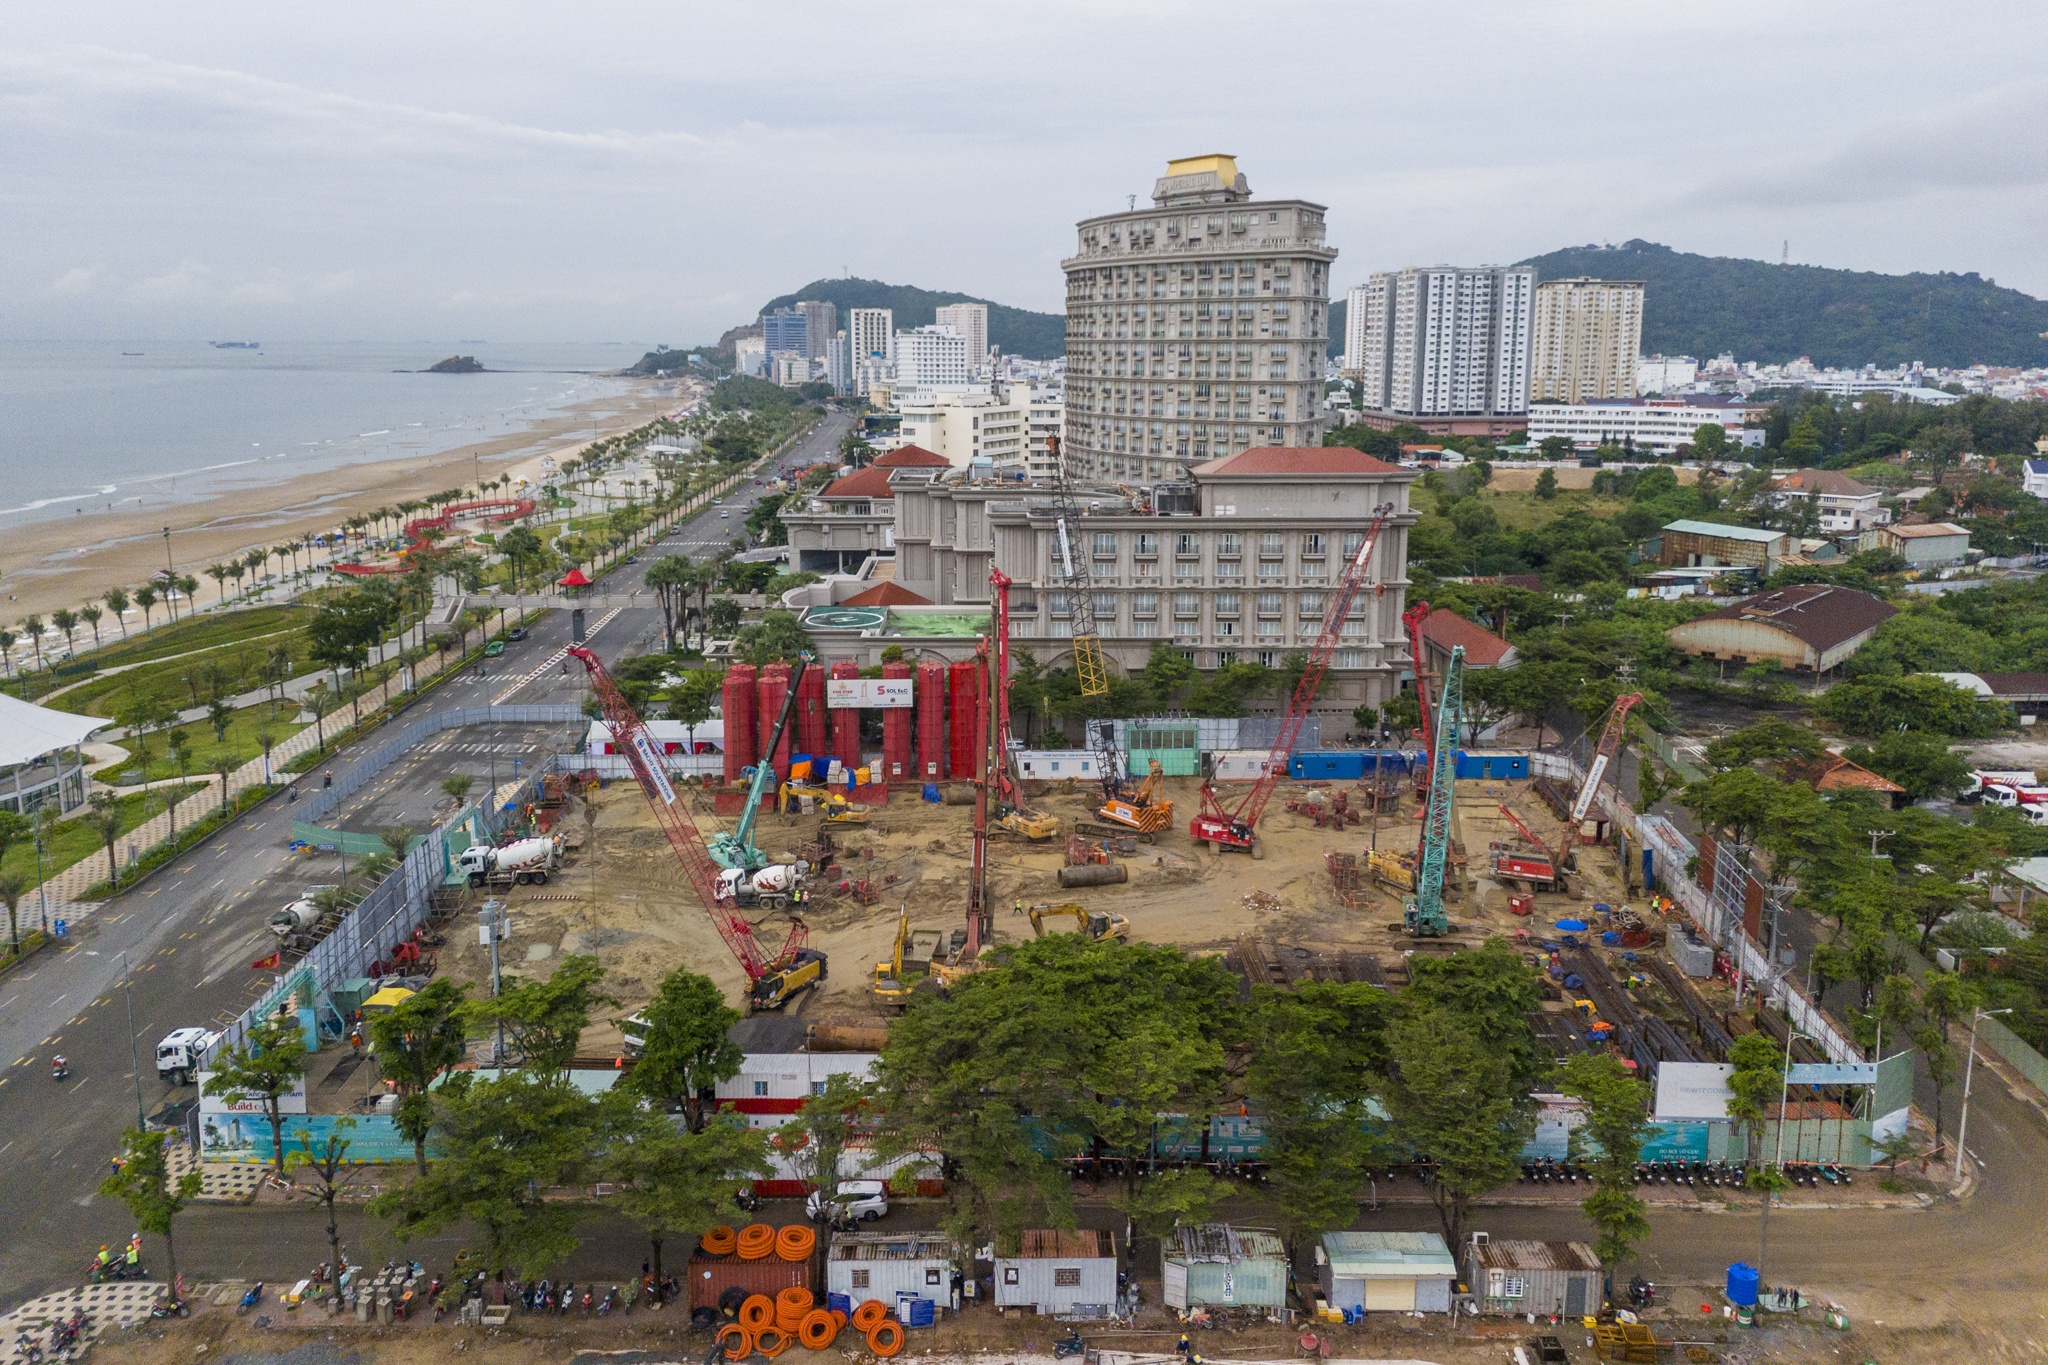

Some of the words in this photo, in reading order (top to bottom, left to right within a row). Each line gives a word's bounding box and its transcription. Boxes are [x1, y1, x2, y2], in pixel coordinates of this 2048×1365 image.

[642, 748, 654, 766] BACHY
[1581, 791, 1590, 806] BACHY
[228, 1102, 252, 1111] Build
